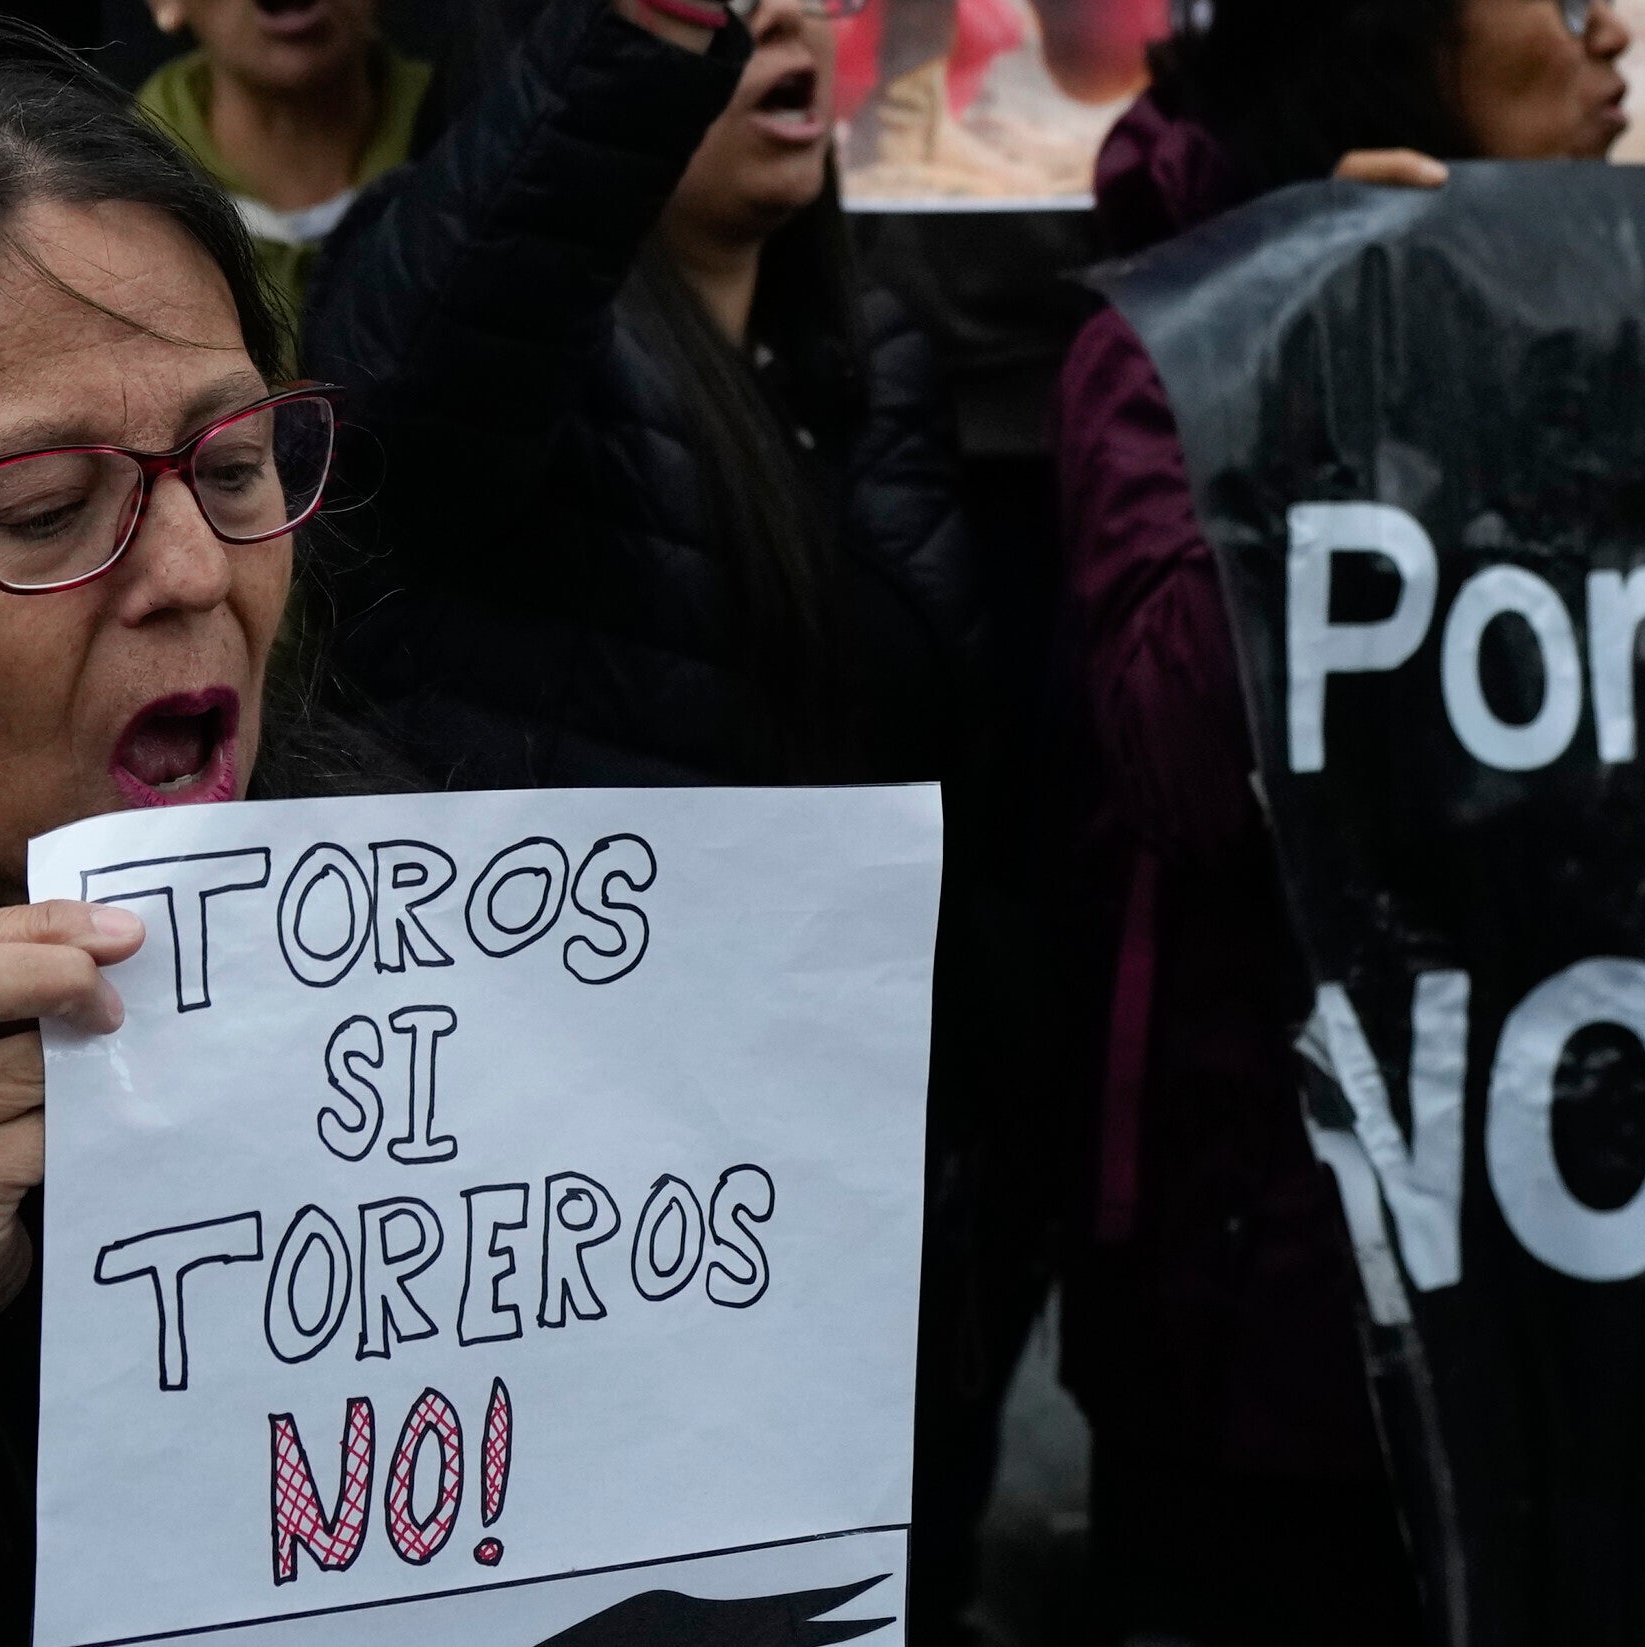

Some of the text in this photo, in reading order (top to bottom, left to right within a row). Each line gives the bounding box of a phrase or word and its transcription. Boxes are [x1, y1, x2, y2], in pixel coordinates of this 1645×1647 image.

[80, 832, 658, 1013] TOROS
[317, 1004, 459, 1165] SI
[94, 1164, 776, 1392] TOREROS
[268, 1376, 513, 1586] NO!
